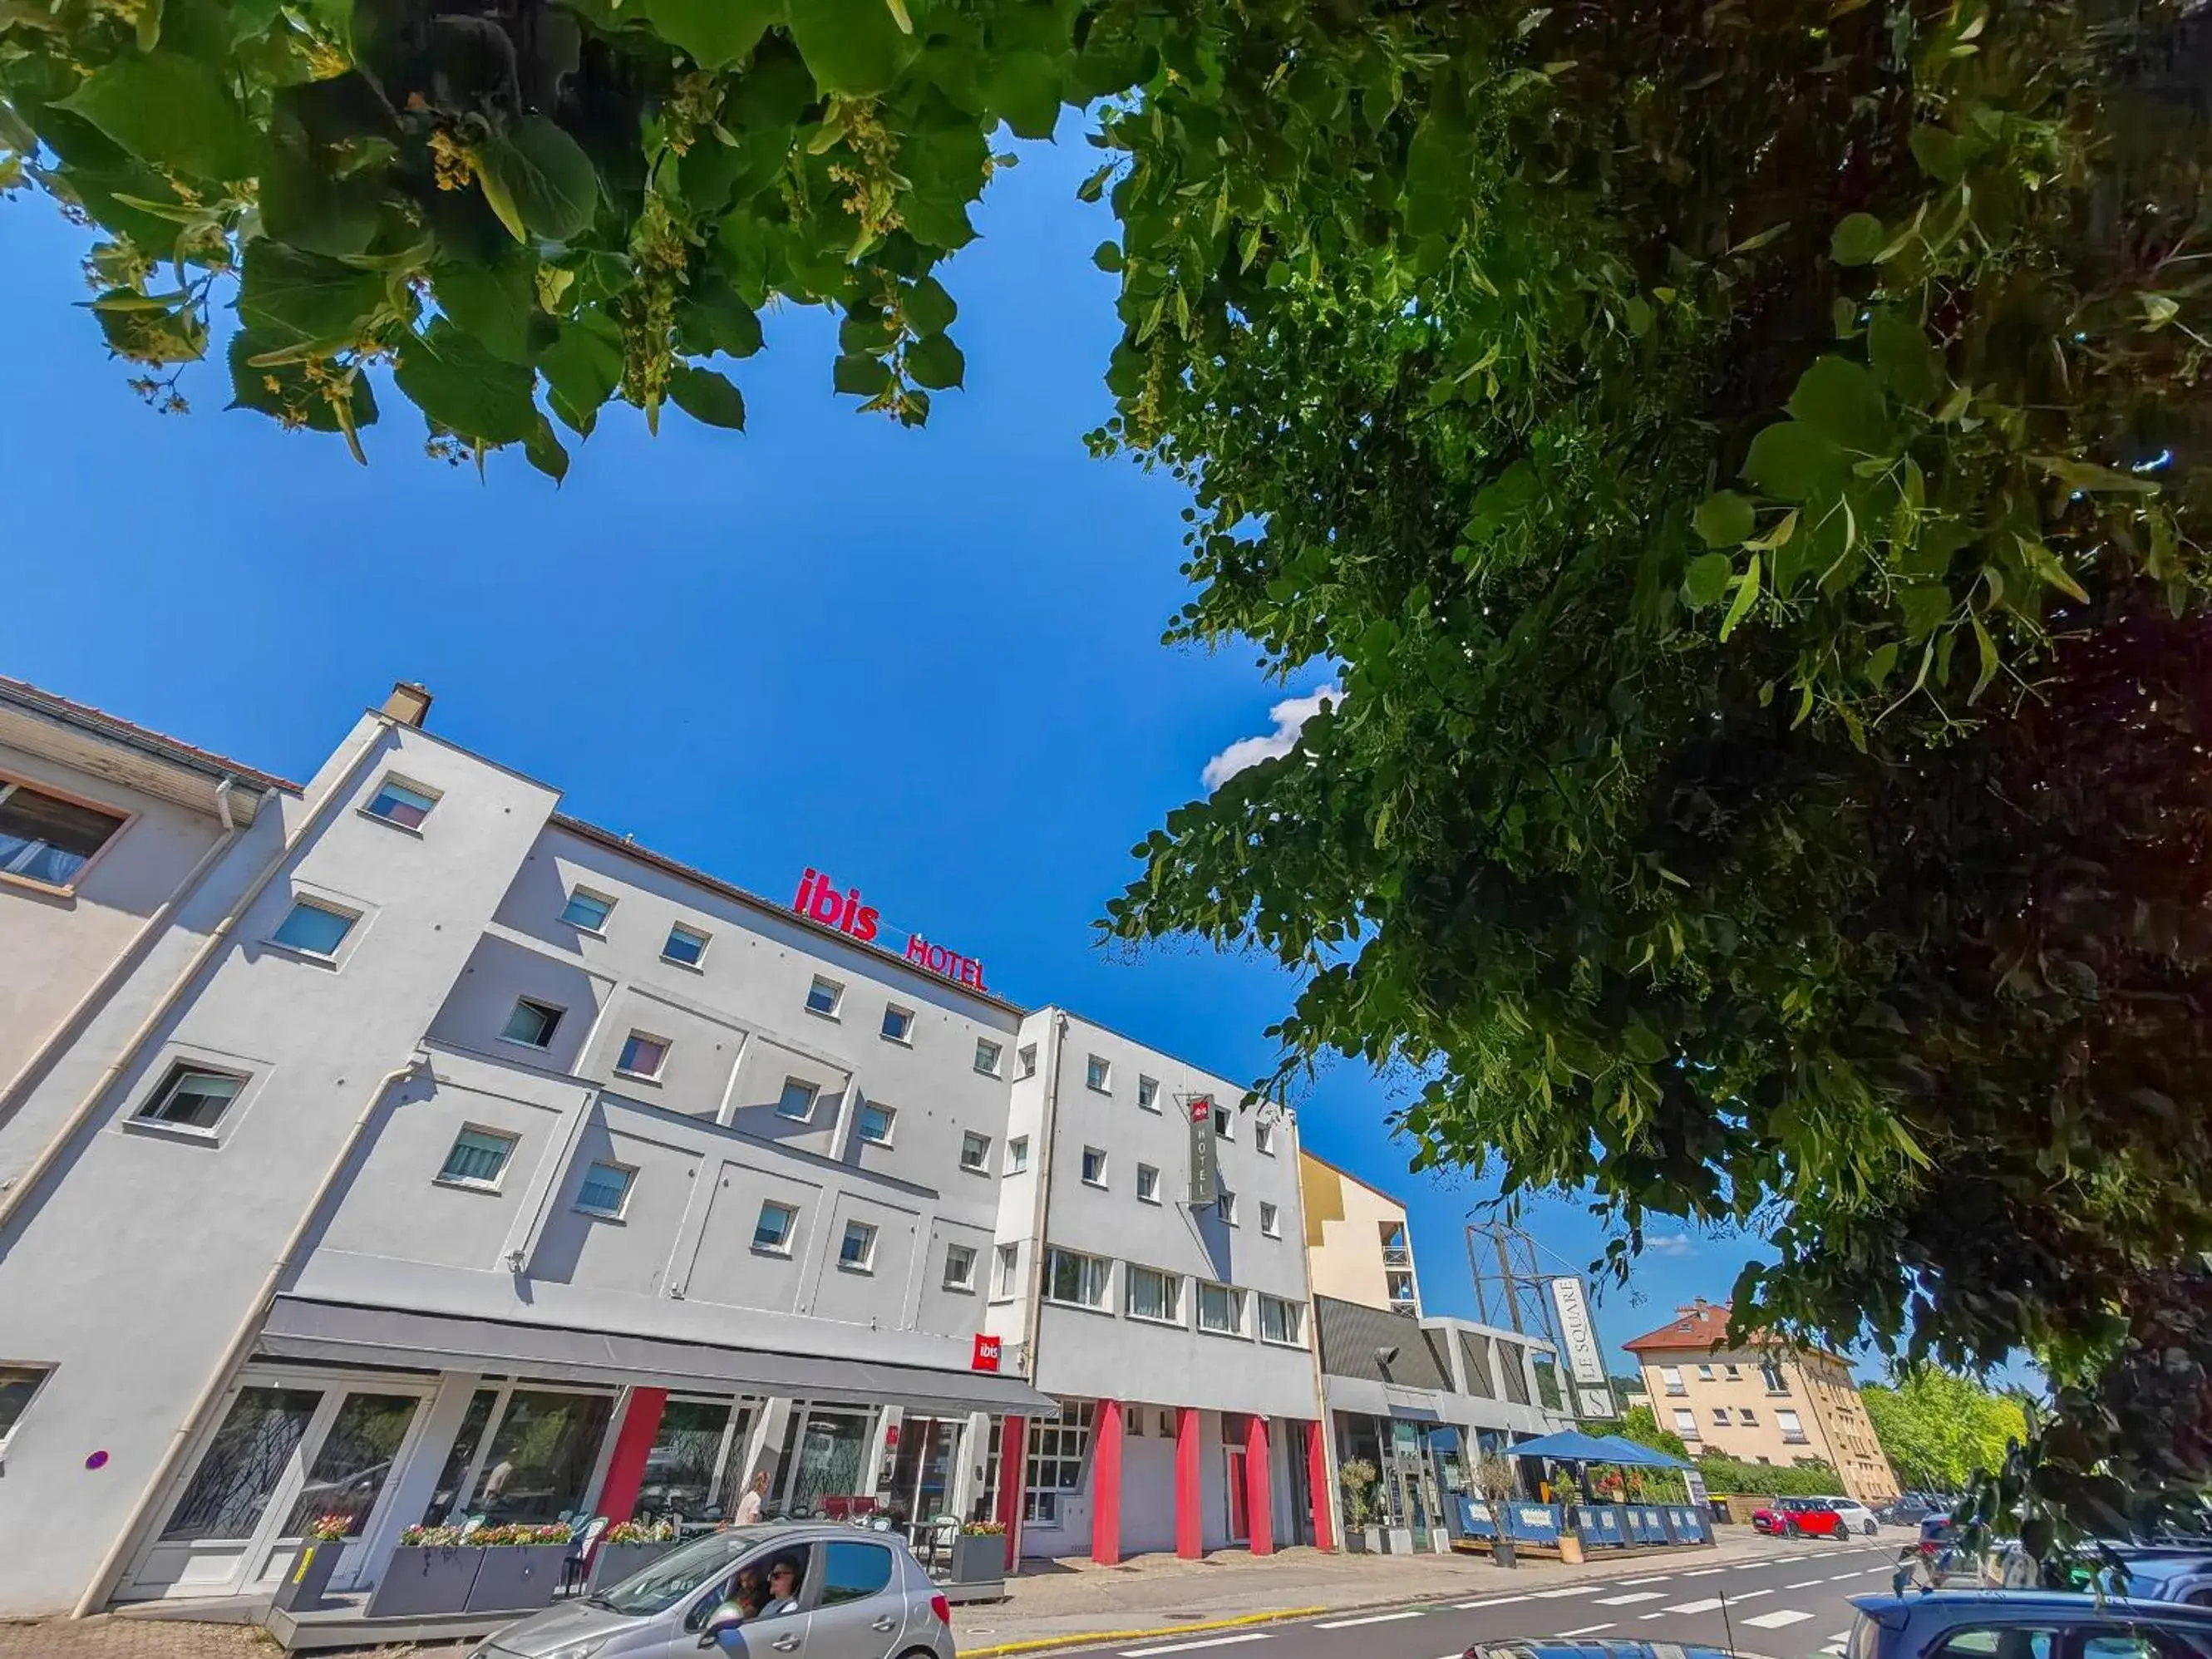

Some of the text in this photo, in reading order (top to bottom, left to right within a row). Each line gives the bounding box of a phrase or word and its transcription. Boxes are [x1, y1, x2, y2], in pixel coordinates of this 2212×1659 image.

[794, 868, 988, 991] ibis HOTEL
[1198, 1130, 1206, 1194] HOTEL
[980, 1343, 998, 1357] ibis
[1559, 1281, 1595, 1379] LE SQUARE
